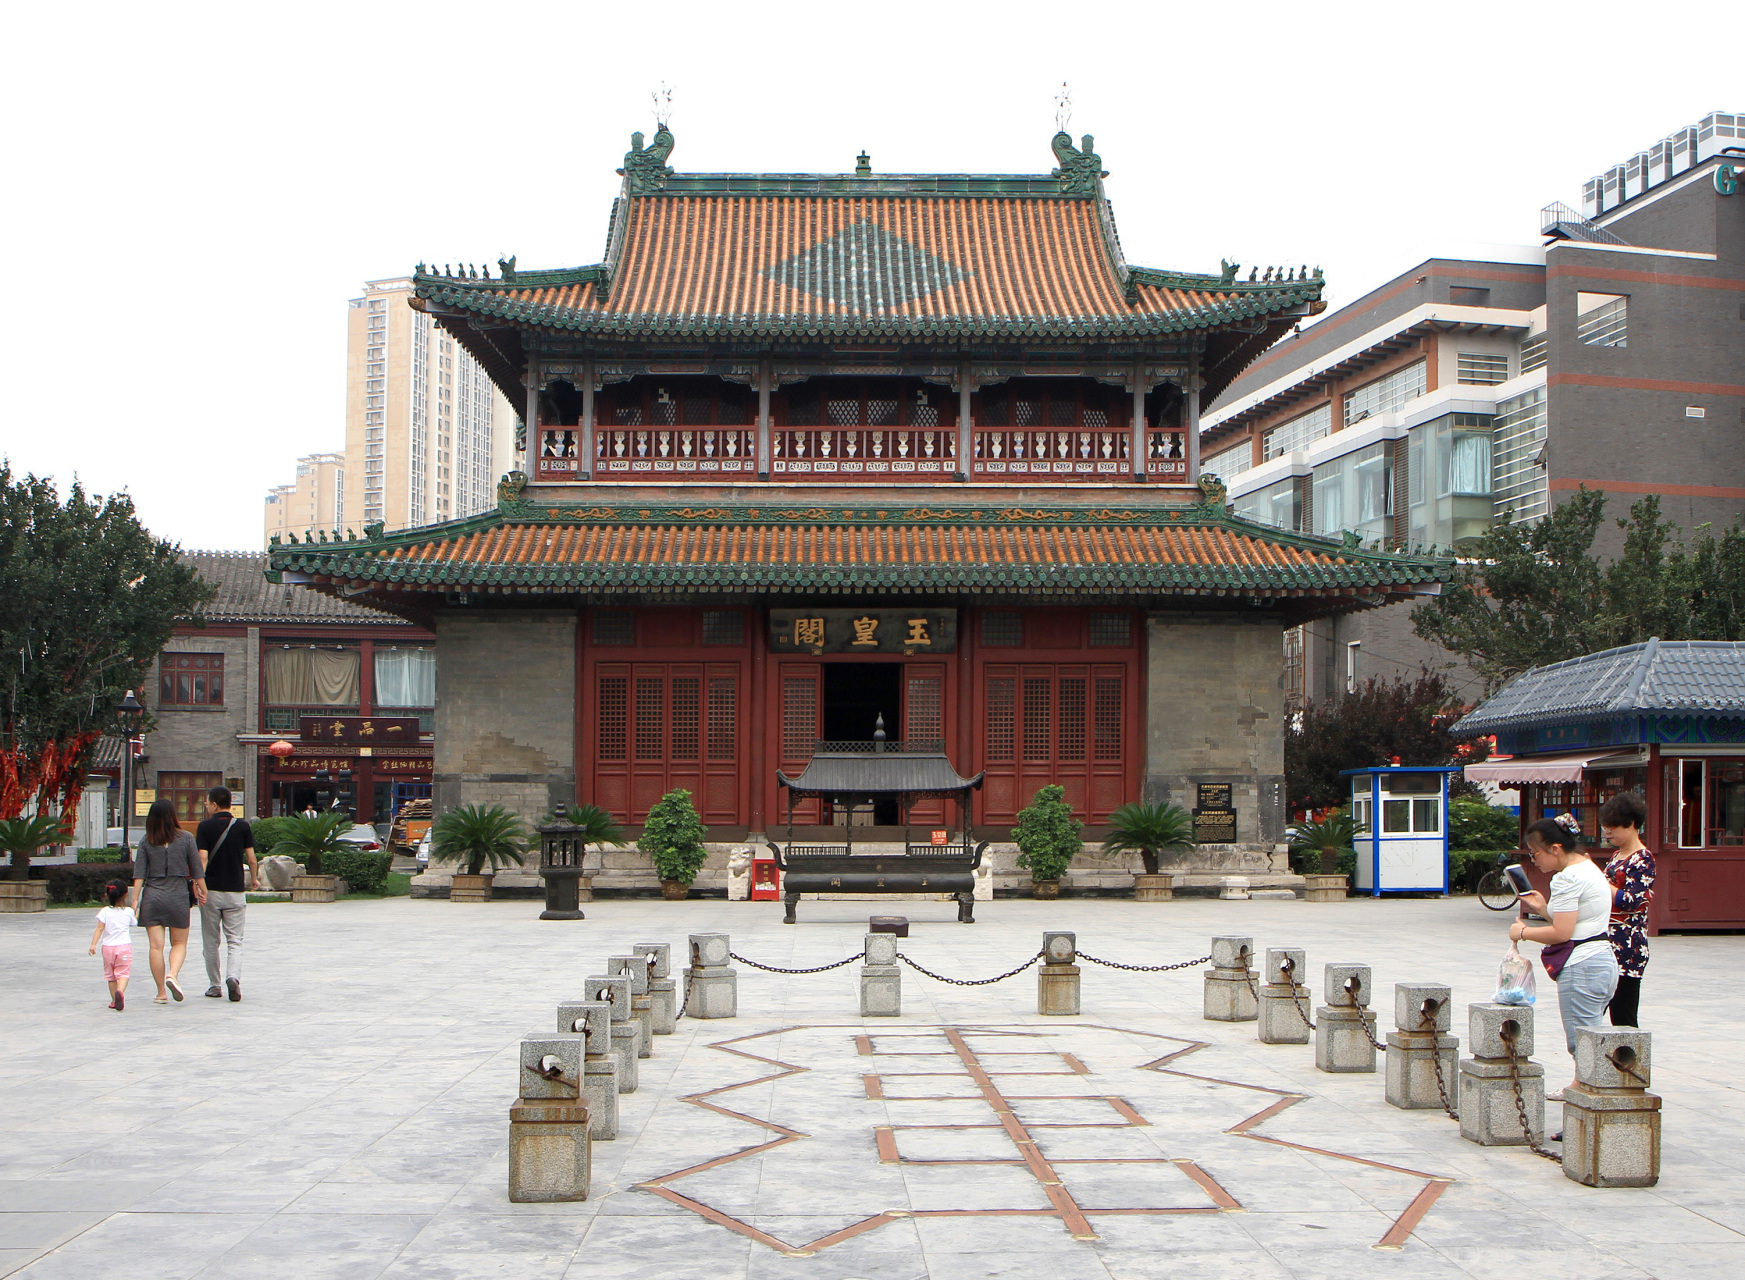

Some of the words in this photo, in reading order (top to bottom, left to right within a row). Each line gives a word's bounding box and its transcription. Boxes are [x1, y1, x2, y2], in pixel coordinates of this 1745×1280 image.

[1713, 163, 1738, 195] G
[794, 616, 932, 648] 玉皇閣
